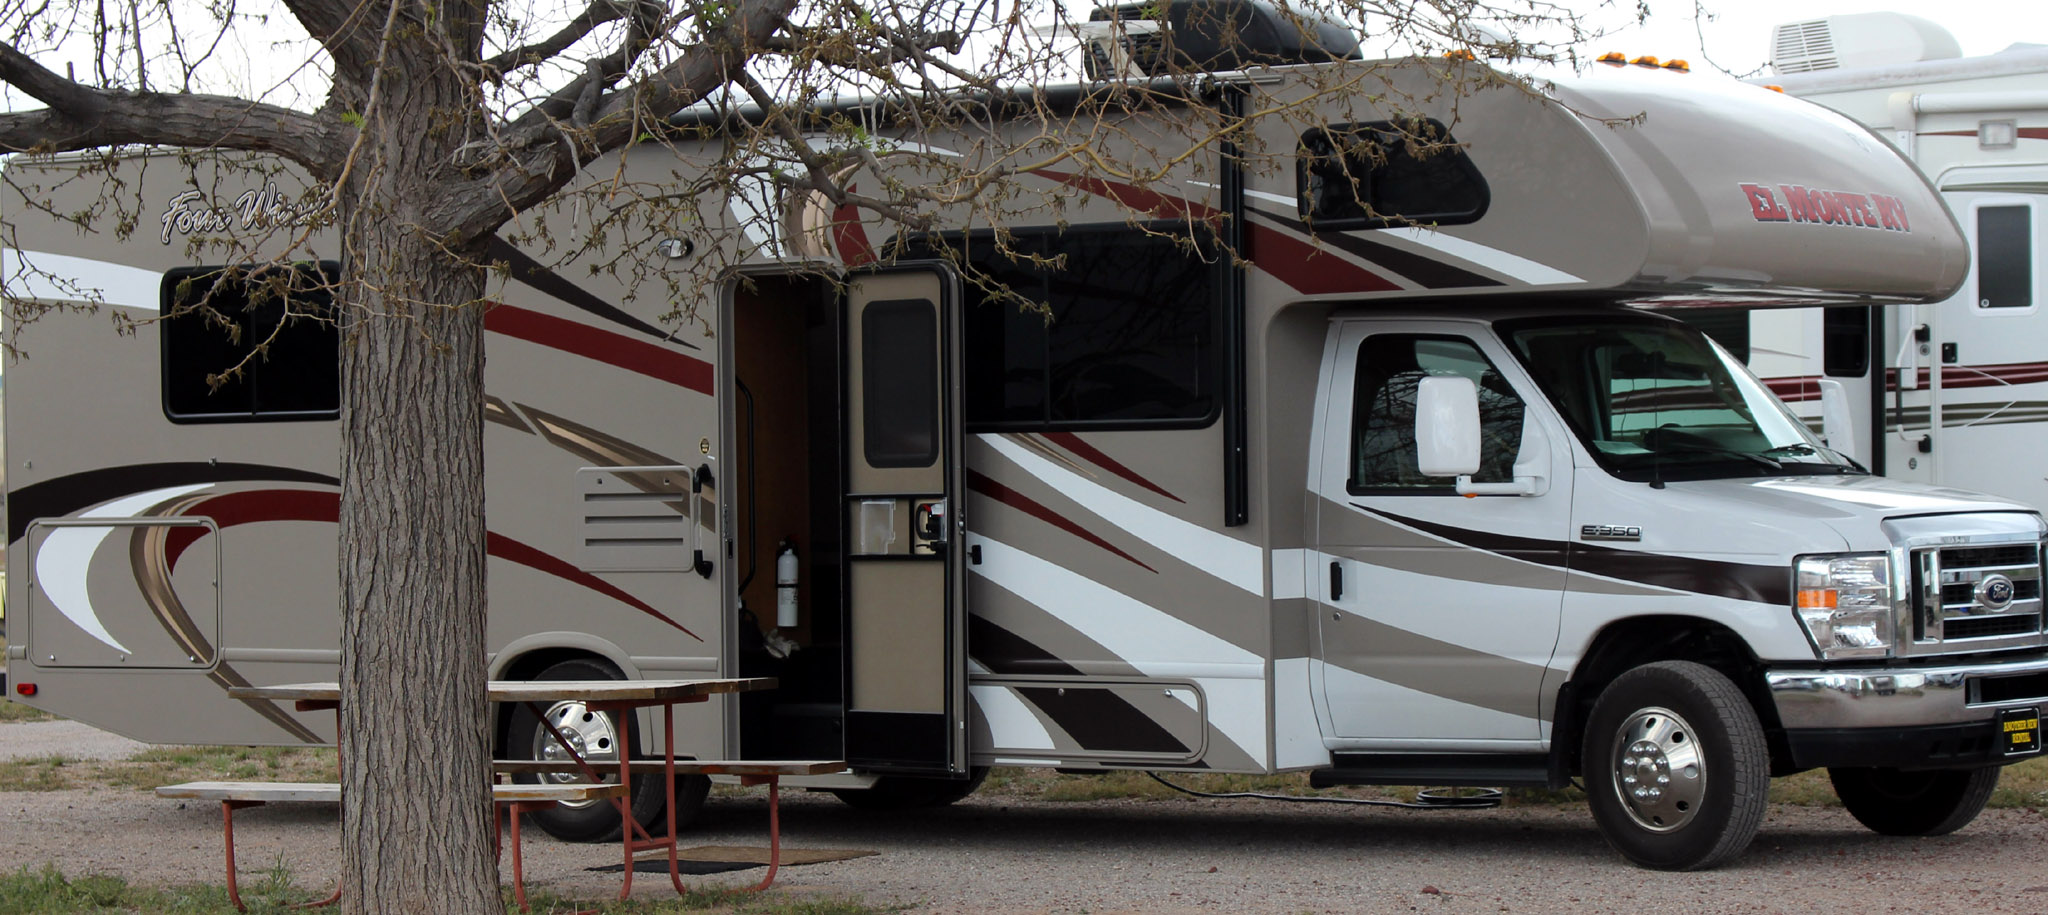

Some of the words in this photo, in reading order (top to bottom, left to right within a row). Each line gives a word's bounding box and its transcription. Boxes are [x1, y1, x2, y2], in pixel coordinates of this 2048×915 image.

[161, 190, 232, 245] Four
[235, 182, 338, 230] Win
[1738, 182, 1791, 223] EL
[1778, 183, 1881, 231] MONTE
[1870, 191, 1912, 234] RV
[1993, 583, 2010, 599] Ford
